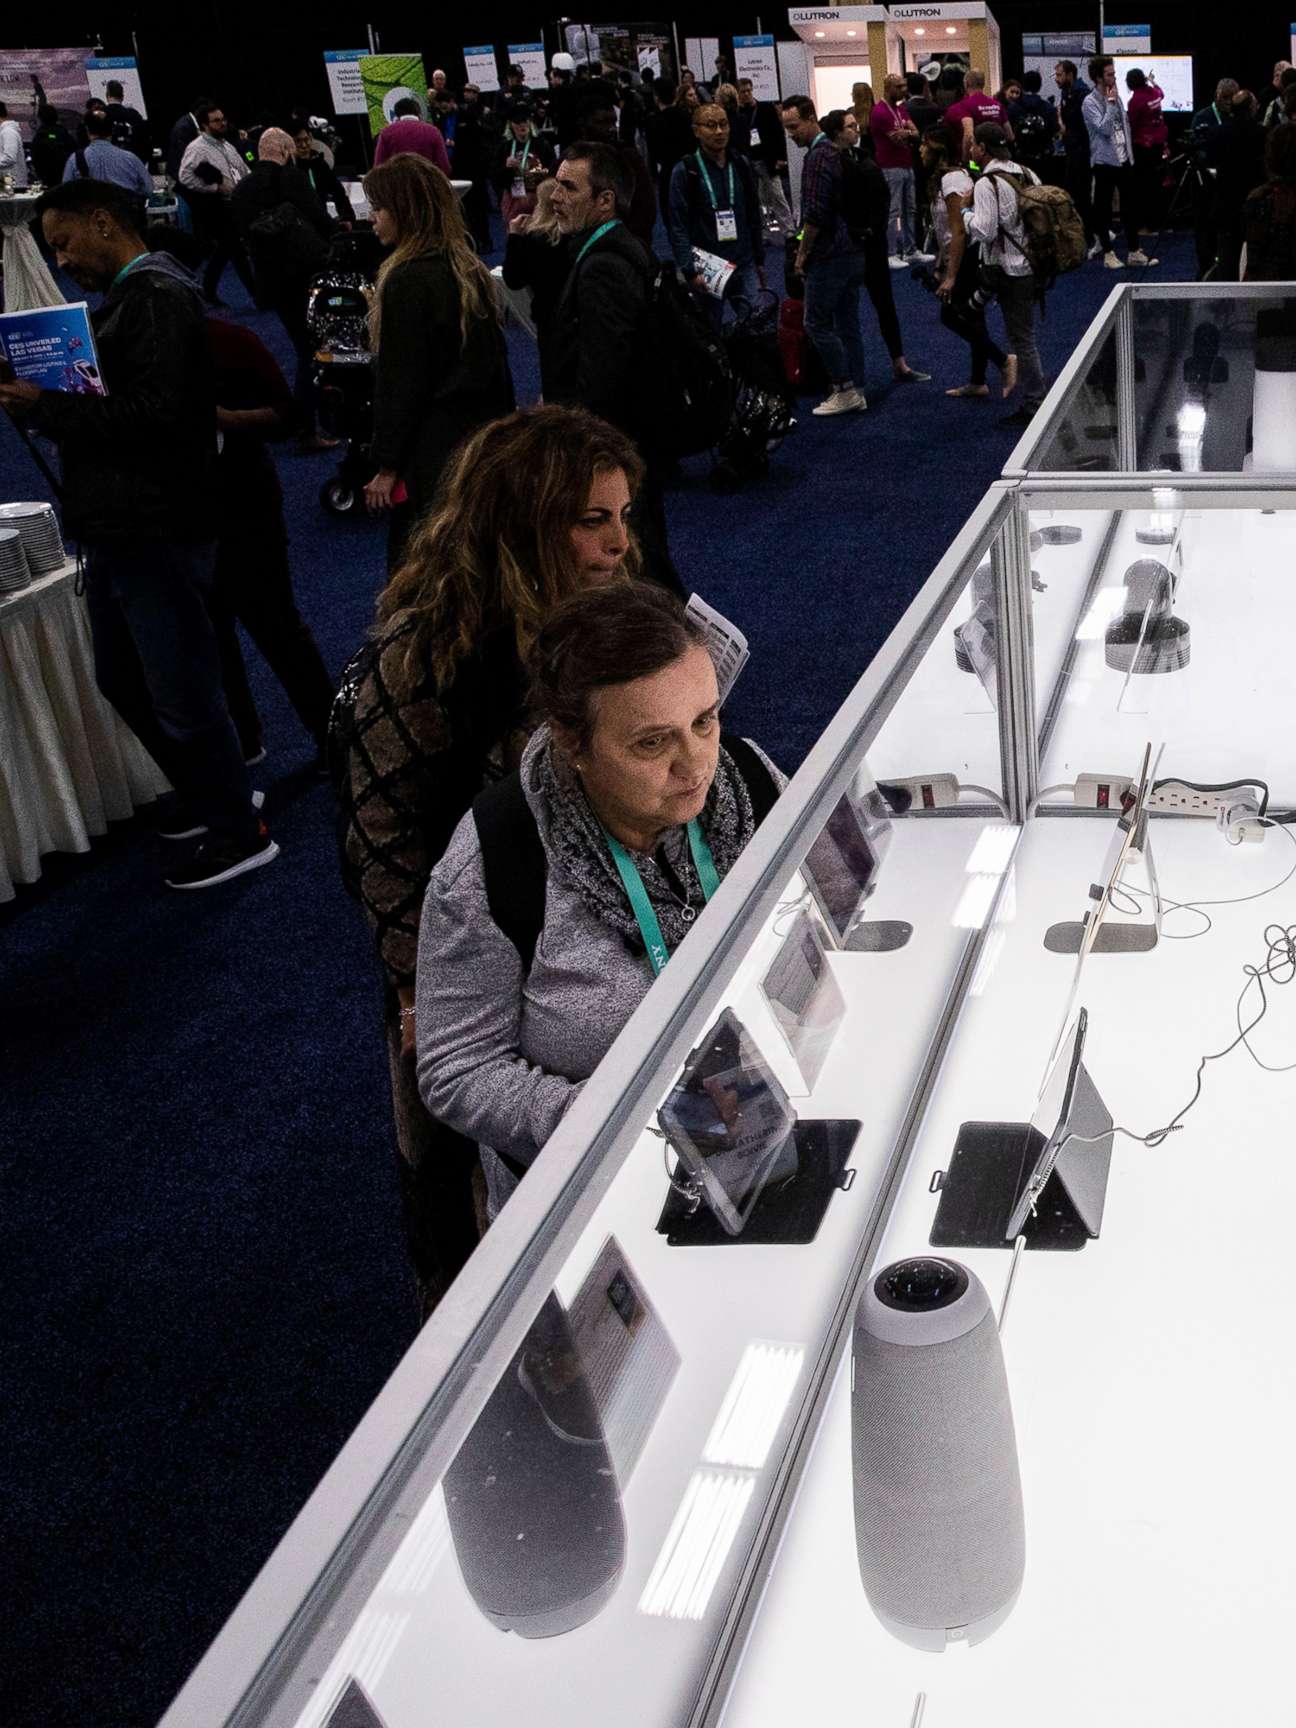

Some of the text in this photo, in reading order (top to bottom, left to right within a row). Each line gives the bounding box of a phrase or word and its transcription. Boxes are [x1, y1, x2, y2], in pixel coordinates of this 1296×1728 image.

[800, 12, 840, 20] LUTRON
[901, 9, 941, 17] LUTRON
[8, 337, 62, 350] CES UNVEILED
[10, 349, 26, 357] LAS
[26, 345, 53, 354] VEGAS
[651, 944, 667, 968] NY
